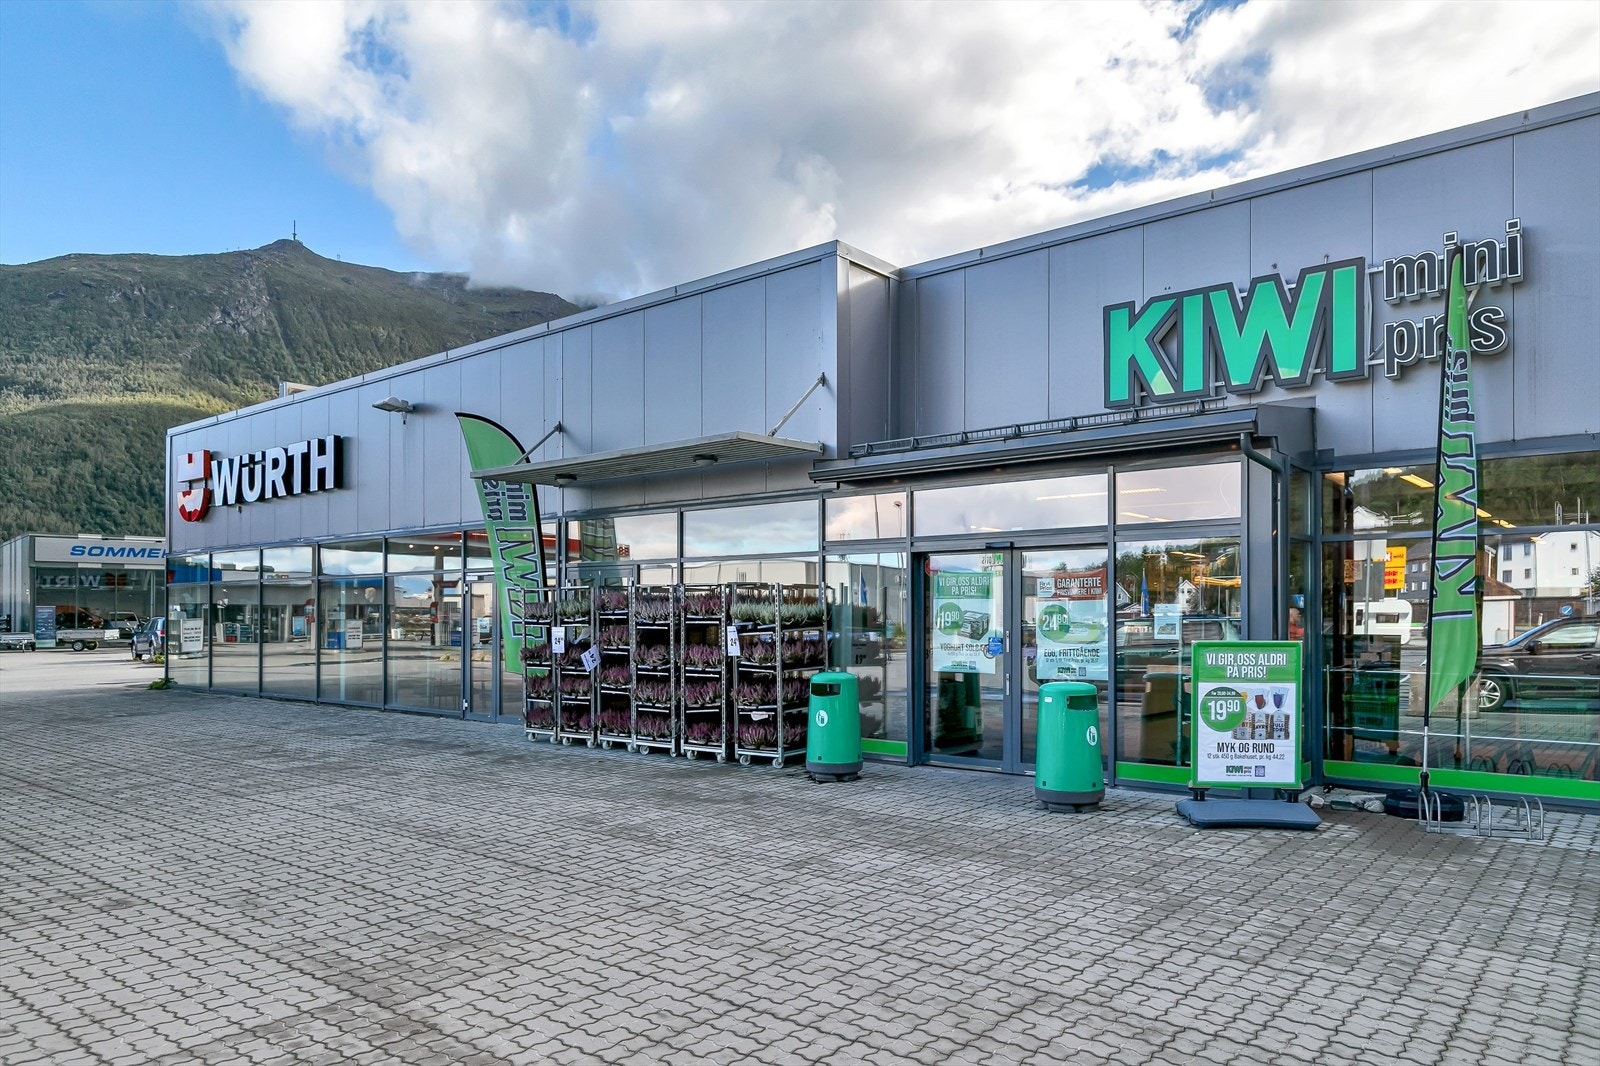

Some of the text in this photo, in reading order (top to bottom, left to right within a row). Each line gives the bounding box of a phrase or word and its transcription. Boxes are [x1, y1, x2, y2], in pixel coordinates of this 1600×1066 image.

[1103, 257, 1367, 409] KIWI
[1384, 304, 1508, 379] prs
[211, 434, 341, 507] WÜRTH
[1432, 427, 1478, 621] KIWI
[938, 577, 945, 587] VI
[957, 577, 970, 586] OSS
[970, 576, 990, 586] ALDRI
[1056, 576, 1102, 589] GARANTERTE
[1058, 646, 1101, 658] FRITTGÅENDE
[1206, 653, 1287, 665] VI GIR OSS ALDRI
[1226, 662, 1267, 678] PÅ PRIS!
[1216, 742, 1275, 754] MYK OG RUND
